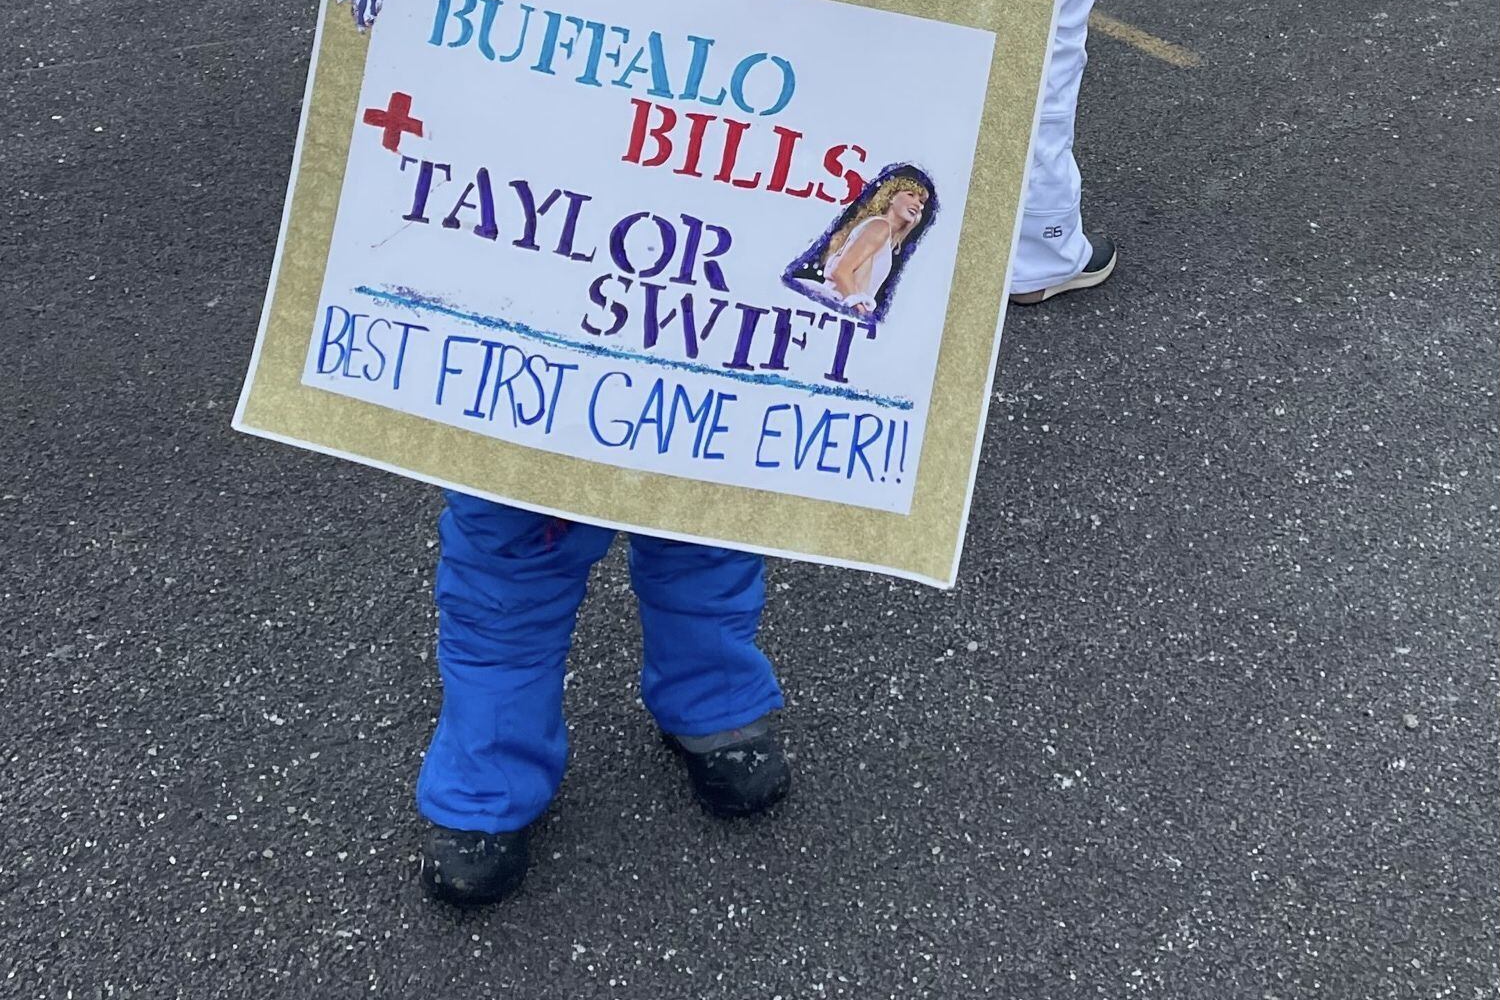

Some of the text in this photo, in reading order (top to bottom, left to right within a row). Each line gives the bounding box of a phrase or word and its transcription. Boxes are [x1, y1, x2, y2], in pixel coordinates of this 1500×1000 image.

[622, 98, 867, 204] BILLS
[400, 155, 734, 293] TAYLOR
[582, 273, 877, 384] SWIFT
[317, 305, 909, 484] BEST FIRST GAME EVER!!
